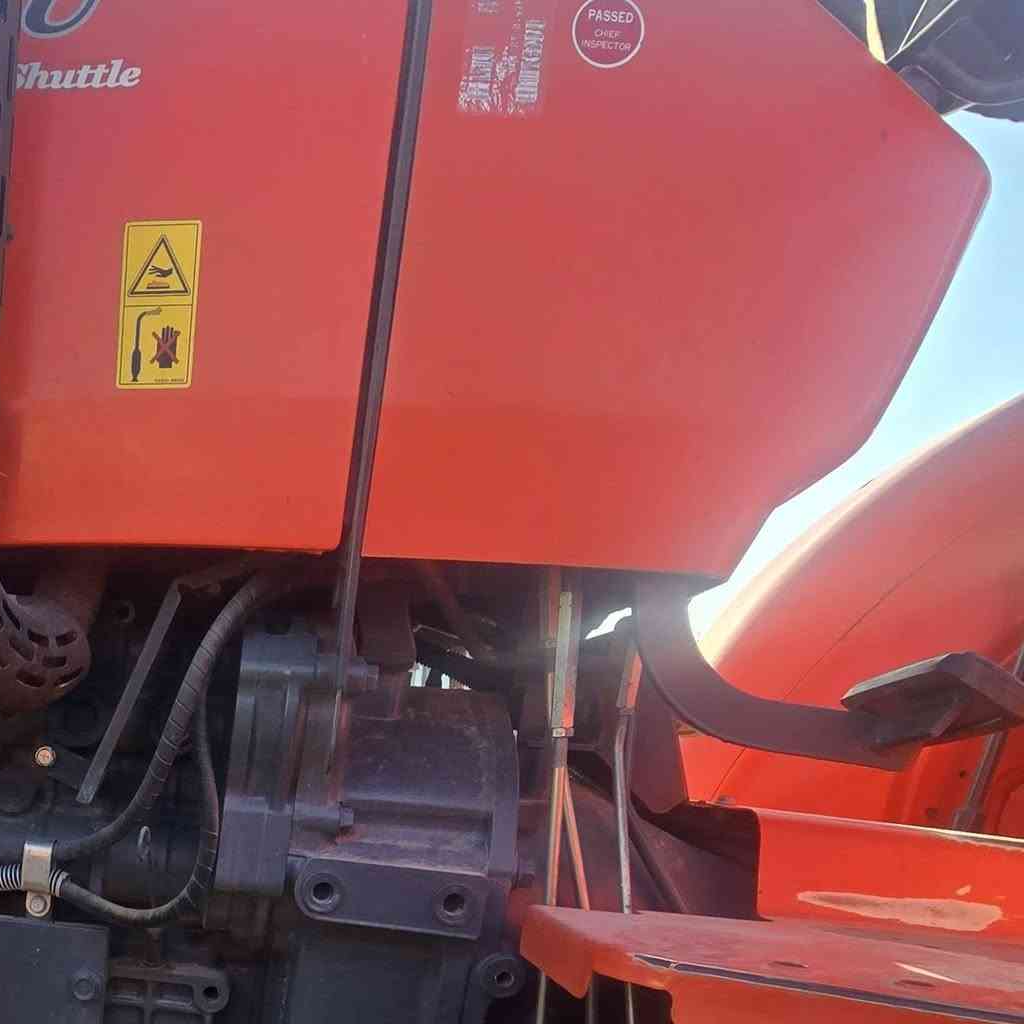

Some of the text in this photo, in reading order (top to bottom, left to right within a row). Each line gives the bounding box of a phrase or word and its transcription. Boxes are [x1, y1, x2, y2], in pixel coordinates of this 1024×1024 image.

[588, 8, 634, 24] PASSED
[594, 28, 621, 38] CHIEF
[579, 39, 633, 52] INSPECTOR
[16, 58, 142, 90] Shuttle
